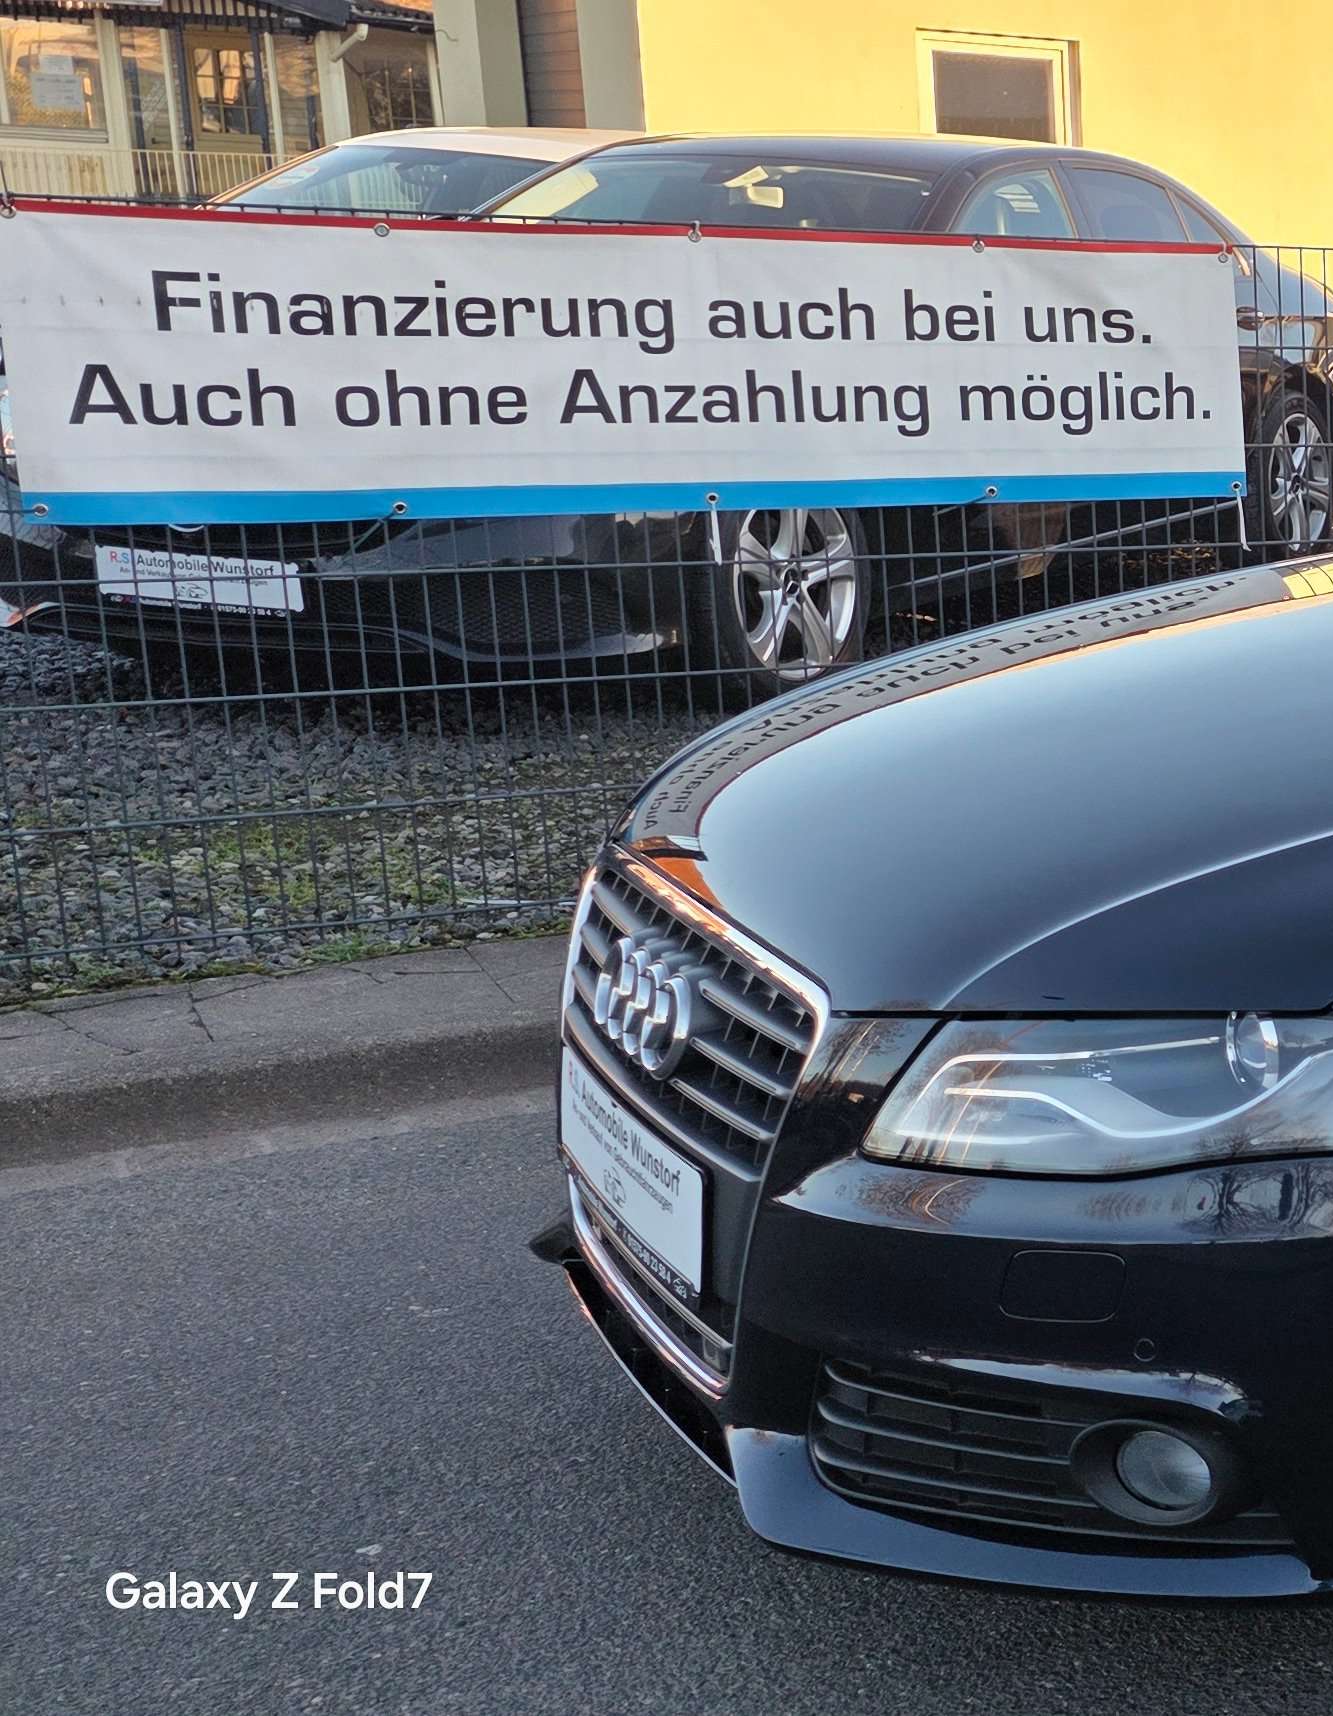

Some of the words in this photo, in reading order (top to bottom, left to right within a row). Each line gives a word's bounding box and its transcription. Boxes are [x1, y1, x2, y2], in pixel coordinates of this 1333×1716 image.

[151, 270, 675, 355] Finanzierung
[708, 287, 875, 341] auch
[904, 288, 995, 343] bei
[1024, 306, 1151, 344] uns.
[69, 364, 296, 427] Auch
[335, 369, 528, 427] ohne
[559, 369, 930, 437] Anzahlung
[959, 371, 1212, 436] möglich.
[137, 554, 209, 572] Automobile
[582, 1079, 628, 1149] Automobile
[630, 1129, 681, 1197] Wunstorf
